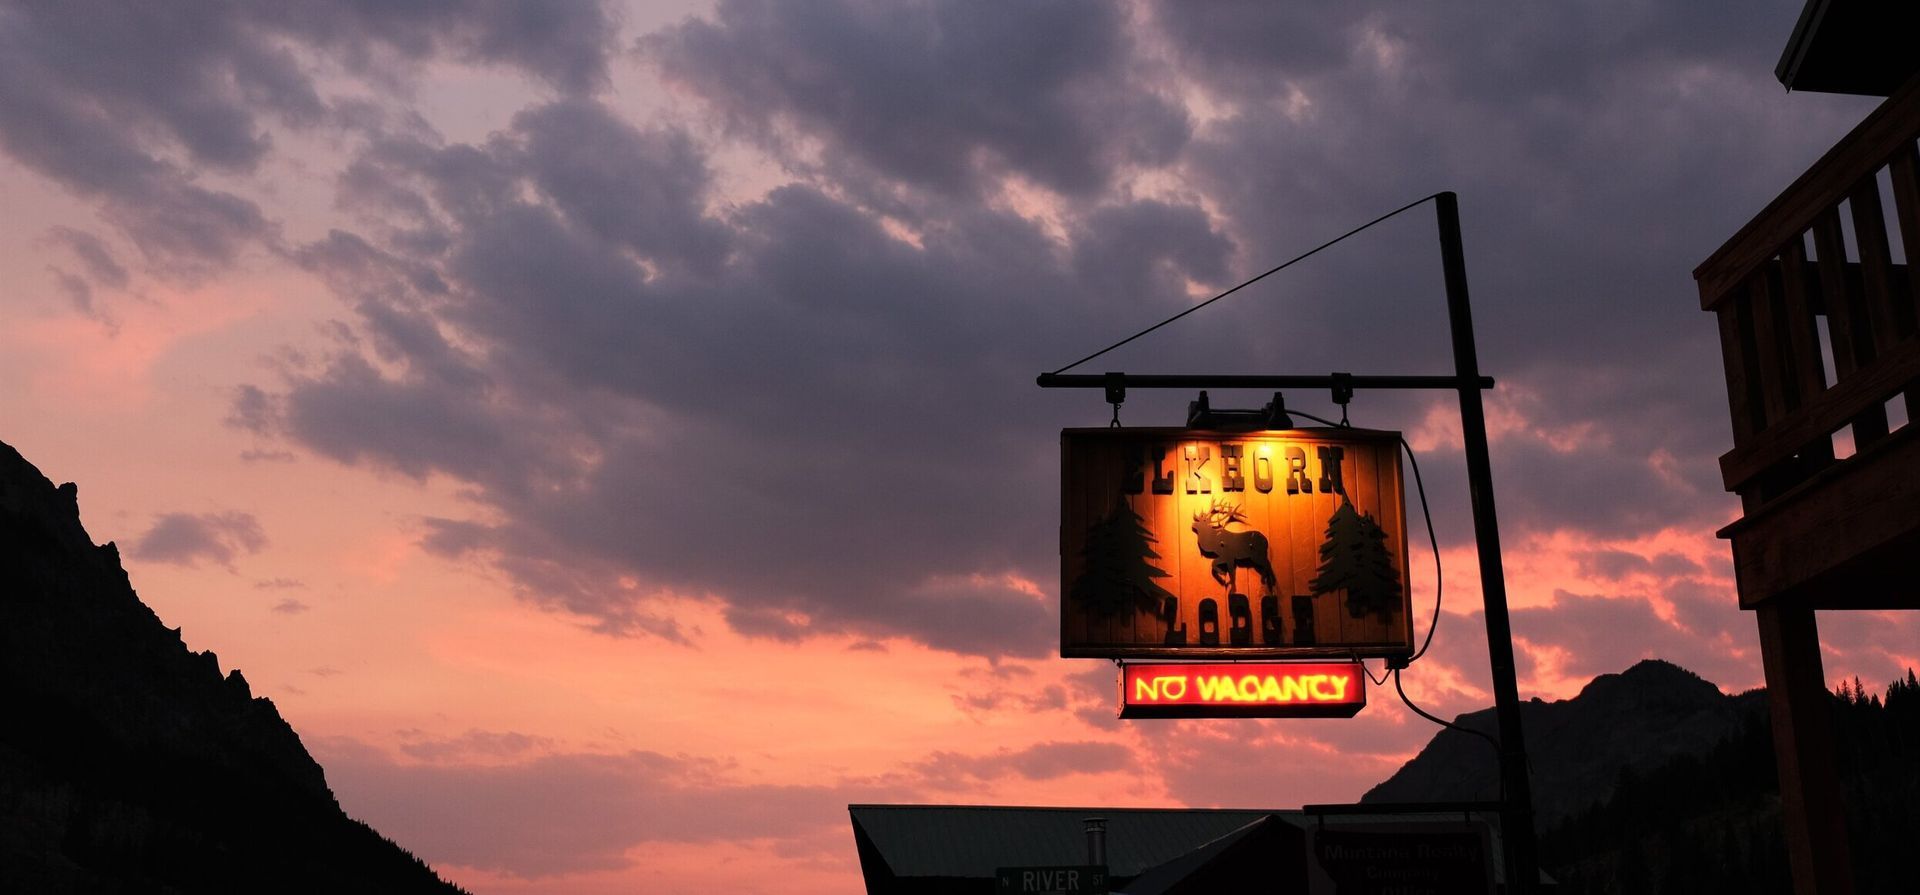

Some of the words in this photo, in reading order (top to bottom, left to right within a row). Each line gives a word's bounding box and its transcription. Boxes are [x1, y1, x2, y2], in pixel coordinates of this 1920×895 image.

[1120, 443, 1344, 494] ELKHORN
[1164, 594, 1315, 646] LODGE
[1136, 676, 1187, 701] NO
[1197, 675, 1347, 702] VACANCY
[1002, 877, 1009, 888] N
[1023, 870, 1080, 892] RIVER
